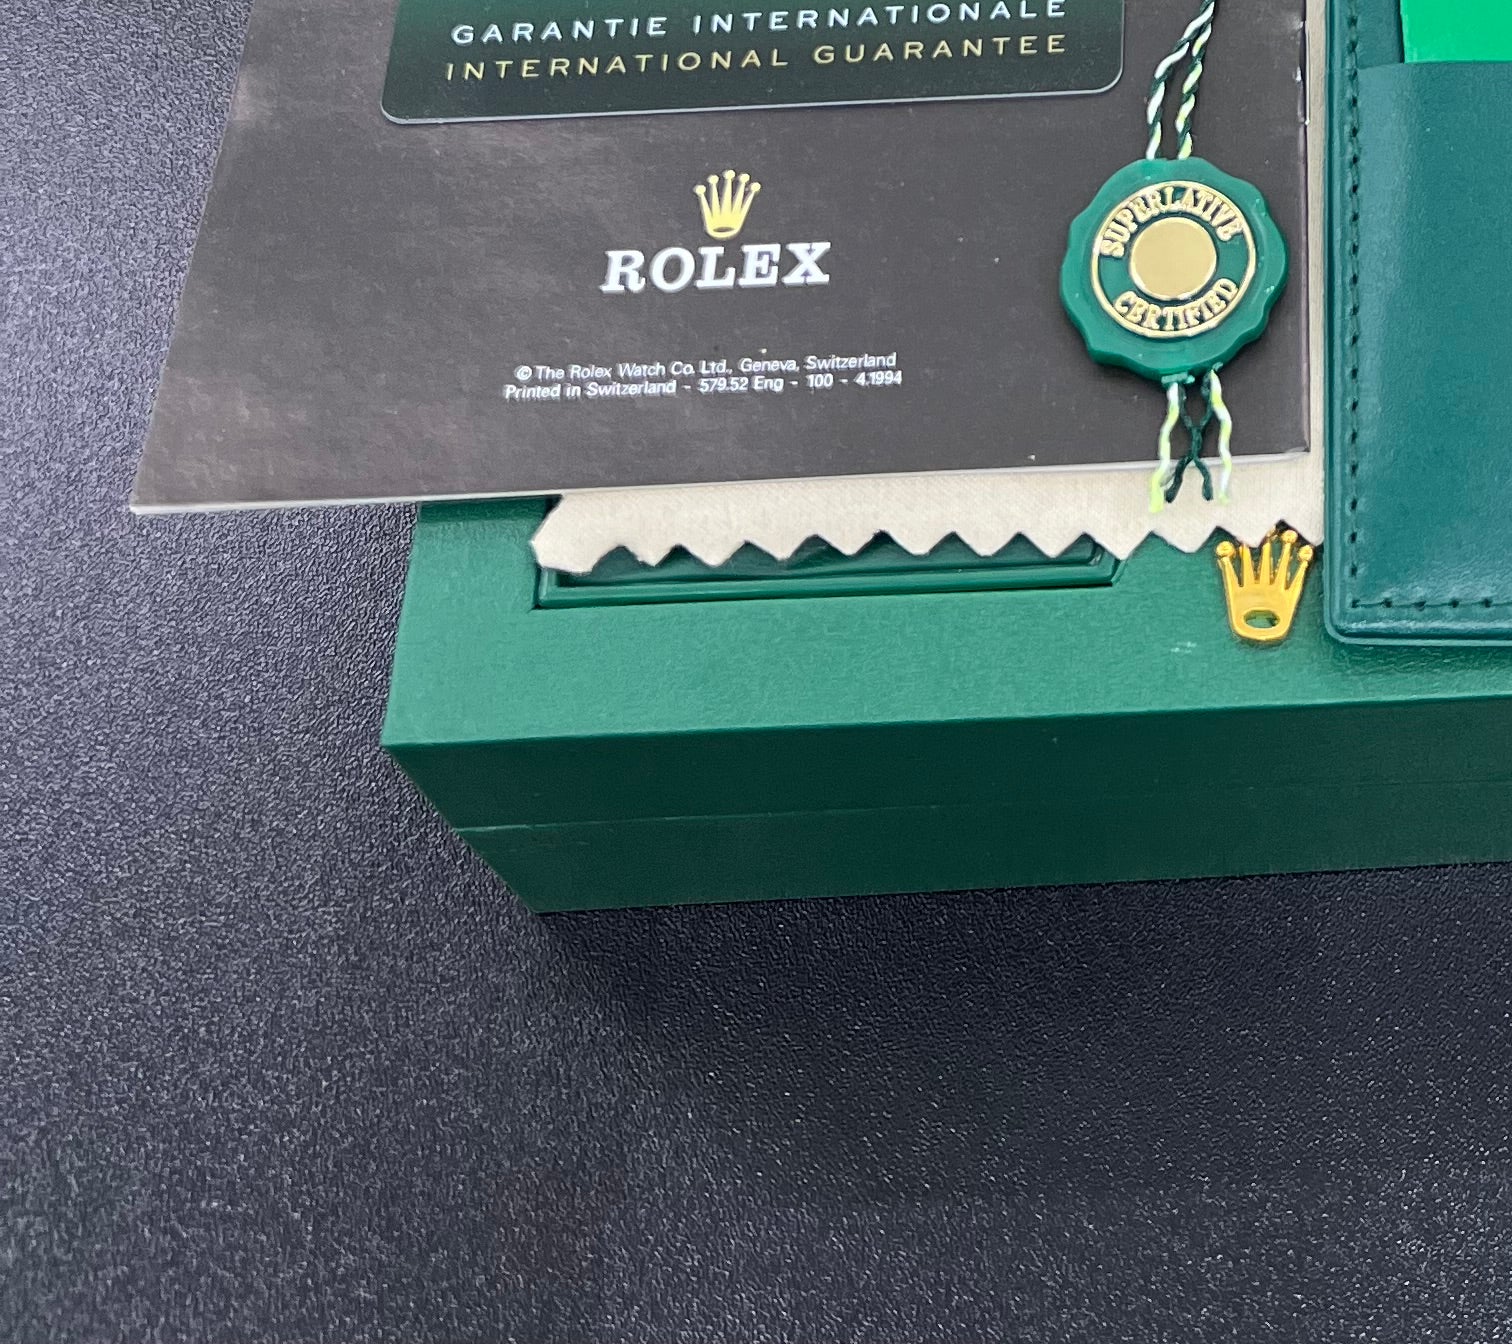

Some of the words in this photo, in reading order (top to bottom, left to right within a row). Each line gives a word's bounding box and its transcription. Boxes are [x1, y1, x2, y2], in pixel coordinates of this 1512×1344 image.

[450, 15, 668, 46] GARANTIE
[445, 48, 789, 81] INTERNATIONAL
[812, 33, 1066, 65] GUARANTEE
[1100, 185, 1244, 258] SUPERLATIVE
[599, 241, 832, 294] ROLEX
[1113, 278, 1240, 332] CERTIFIED
[504, 383, 562, 402] Printed
[565, 382, 582, 398] in
[585, 379, 678, 399] Switzerland
[697, 376, 749, 394] 579.52
[752, 375, 785, 393] Eng
[806, 372, 835, 389] 100
[569, 363, 613, 381] Rolex
[616, 362, 666, 379] Watch
[670, 360, 696, 376] Co.
[804, 352, 897, 371] Switzerland
